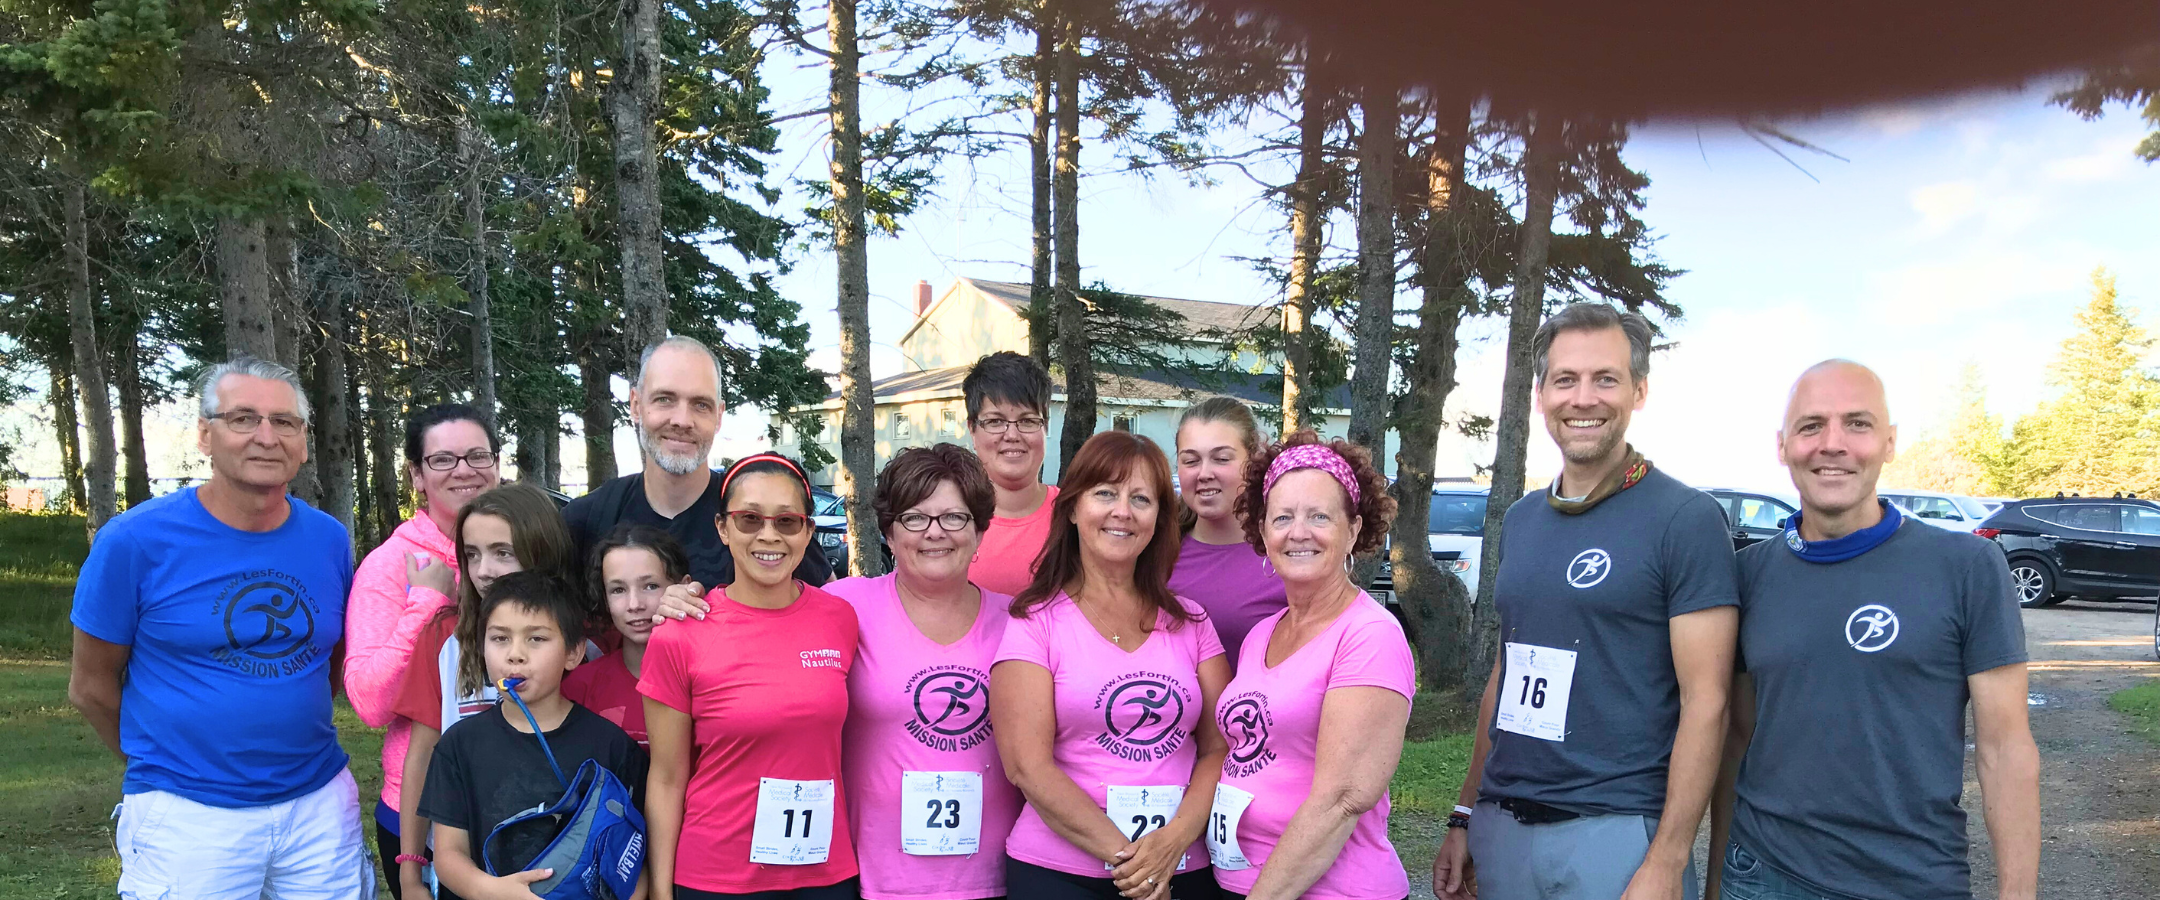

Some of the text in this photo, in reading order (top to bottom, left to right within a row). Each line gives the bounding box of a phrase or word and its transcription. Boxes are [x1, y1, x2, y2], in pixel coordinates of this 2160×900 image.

[211, 568, 320, 616] www.LesFortin.ca
[209, 646, 279, 678] MISSION
[801, 658, 842, 669] Nautilus
[904, 664, 990, 693] www.LesFortin.
[1094, 670, 1192, 710] www.LesFortin.ca
[1519, 675, 1548, 709] 16
[904, 718, 957, 752] MISSION
[1095, 726, 1187, 762] MISSION SANTÉ
[783, 809, 813, 838] 11
[926, 799, 960, 828] 23
[1213, 812, 1226, 845] 15
[615, 832, 644, 883] AMELBAK
